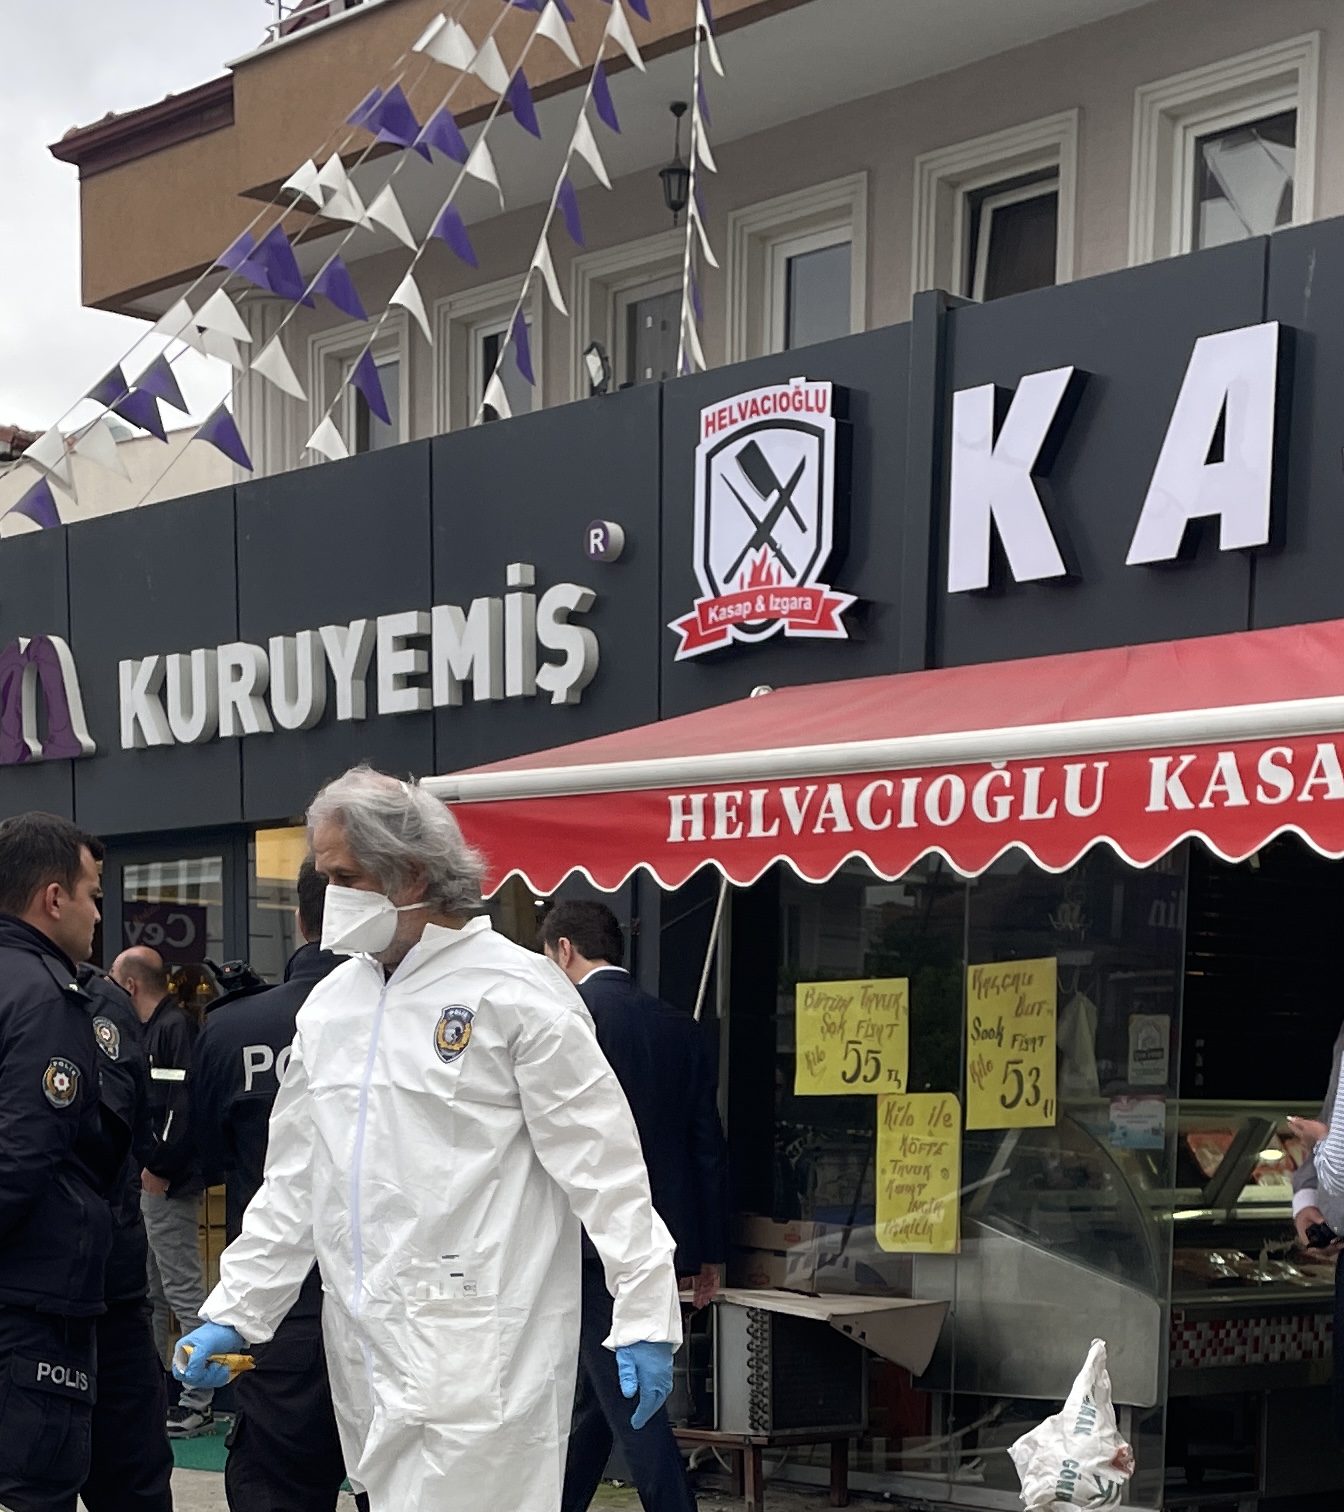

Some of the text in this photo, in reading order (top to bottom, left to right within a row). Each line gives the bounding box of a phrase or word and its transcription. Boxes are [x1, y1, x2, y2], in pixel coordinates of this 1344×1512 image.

[706, 385, 827, 437] HELVACIOĞLU
[709, 600, 751, 625] Kasap
[756, 595, 765, 611] &
[118, 563, 599, 750] KURUYEMİŞ
[667, 760, 1108, 843] HELVACIOĞLU
[841, 1040, 882, 1084] 55
[1000, 1059, 1041, 1109] 53
